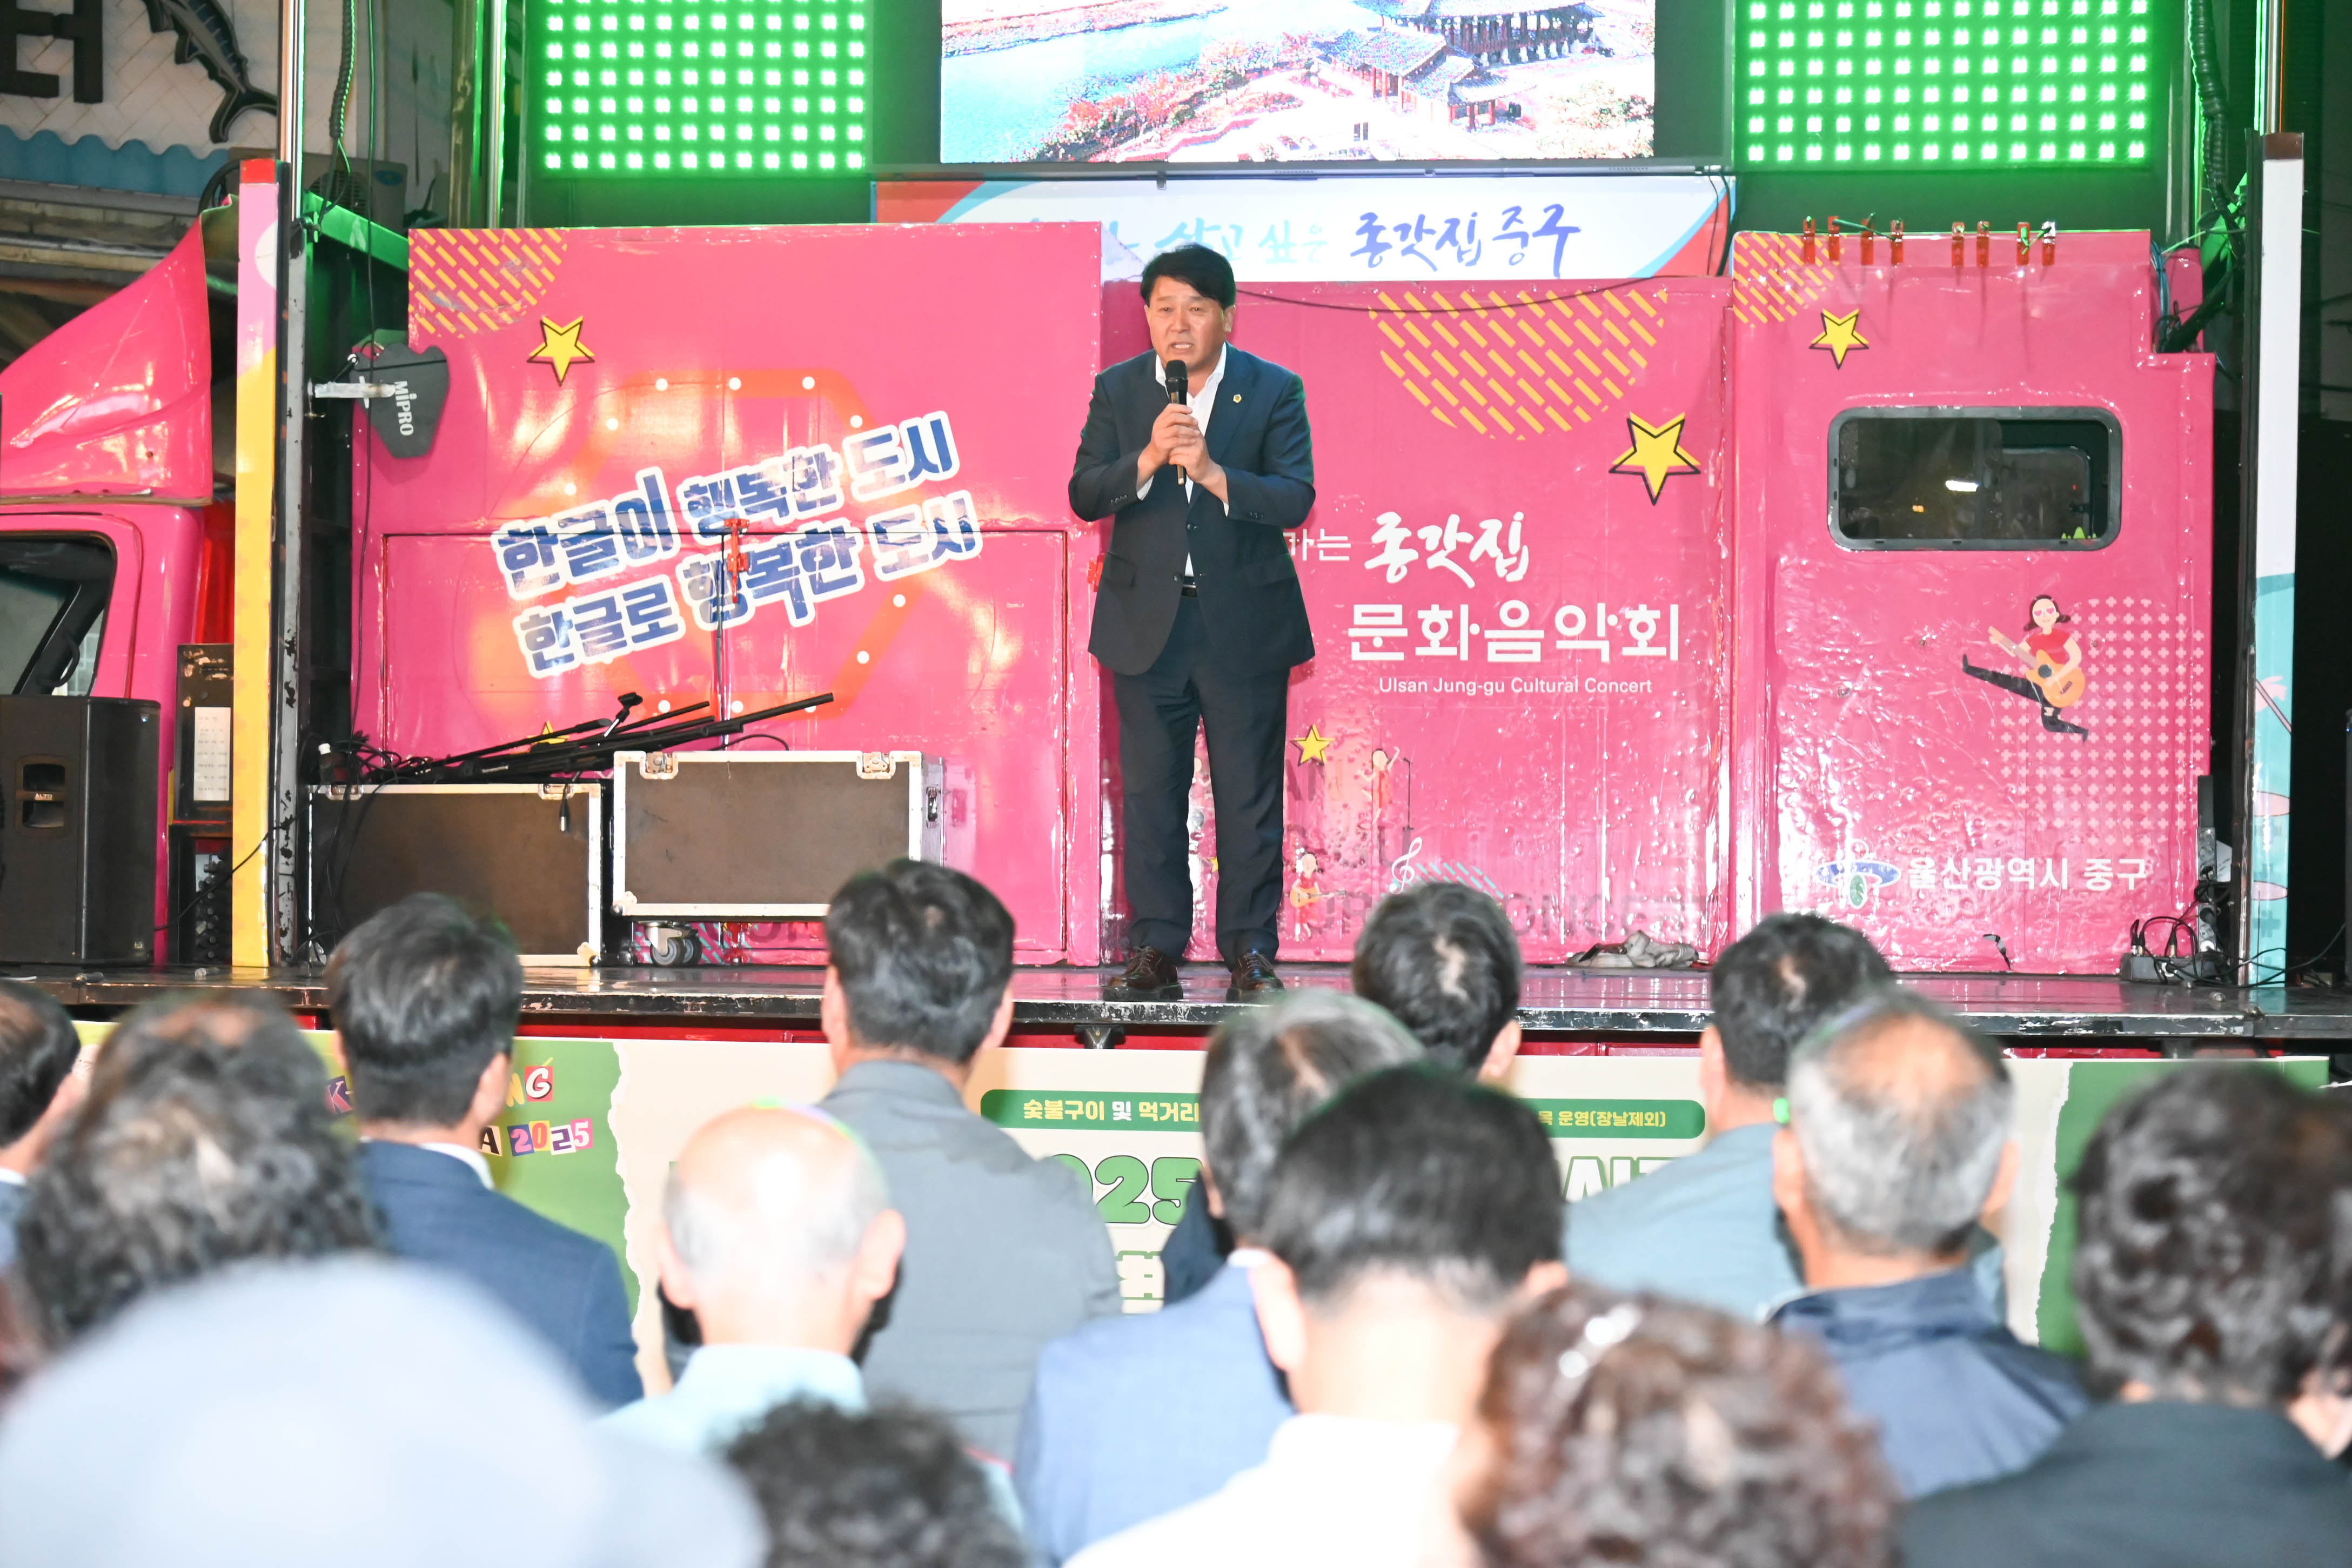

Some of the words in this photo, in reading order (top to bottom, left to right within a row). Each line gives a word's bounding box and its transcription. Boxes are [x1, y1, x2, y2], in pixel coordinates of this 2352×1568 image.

[1492, 203, 1582, 279] 중구
[494, 472, 678, 595] 한글이
[682, 450, 842, 537] 행복한
[846, 418, 955, 497] 도시
[1283, 528, 1351, 561] 가는
[1364, 511, 1529, 588] 종갓집
[518, 583, 680, 673] 한글로
[682, 523, 860, 623] 행복한
[868, 496, 980, 577] 도시
[1348, 600, 1679, 662] 문화음악회
[1379, 677, 1428, 693] Ulsan
[1433, 677, 1505, 695] Jung-gu
[1511, 677, 1579, 693] Cultural
[1584, 677, 1652, 693] Concert
[1908, 856, 2068, 890] 울산광역시
[2083, 857, 2147, 890] 중구
[1023, 1099, 1104, 1121] 숯불구이
[1112, 1101, 1132, 1121] 및
[1138, 1102, 1200, 1122] 먹거리
[1558, 1110, 1666, 1127] 운영(장날제외)
[510, 1121, 590, 1153] 2025
